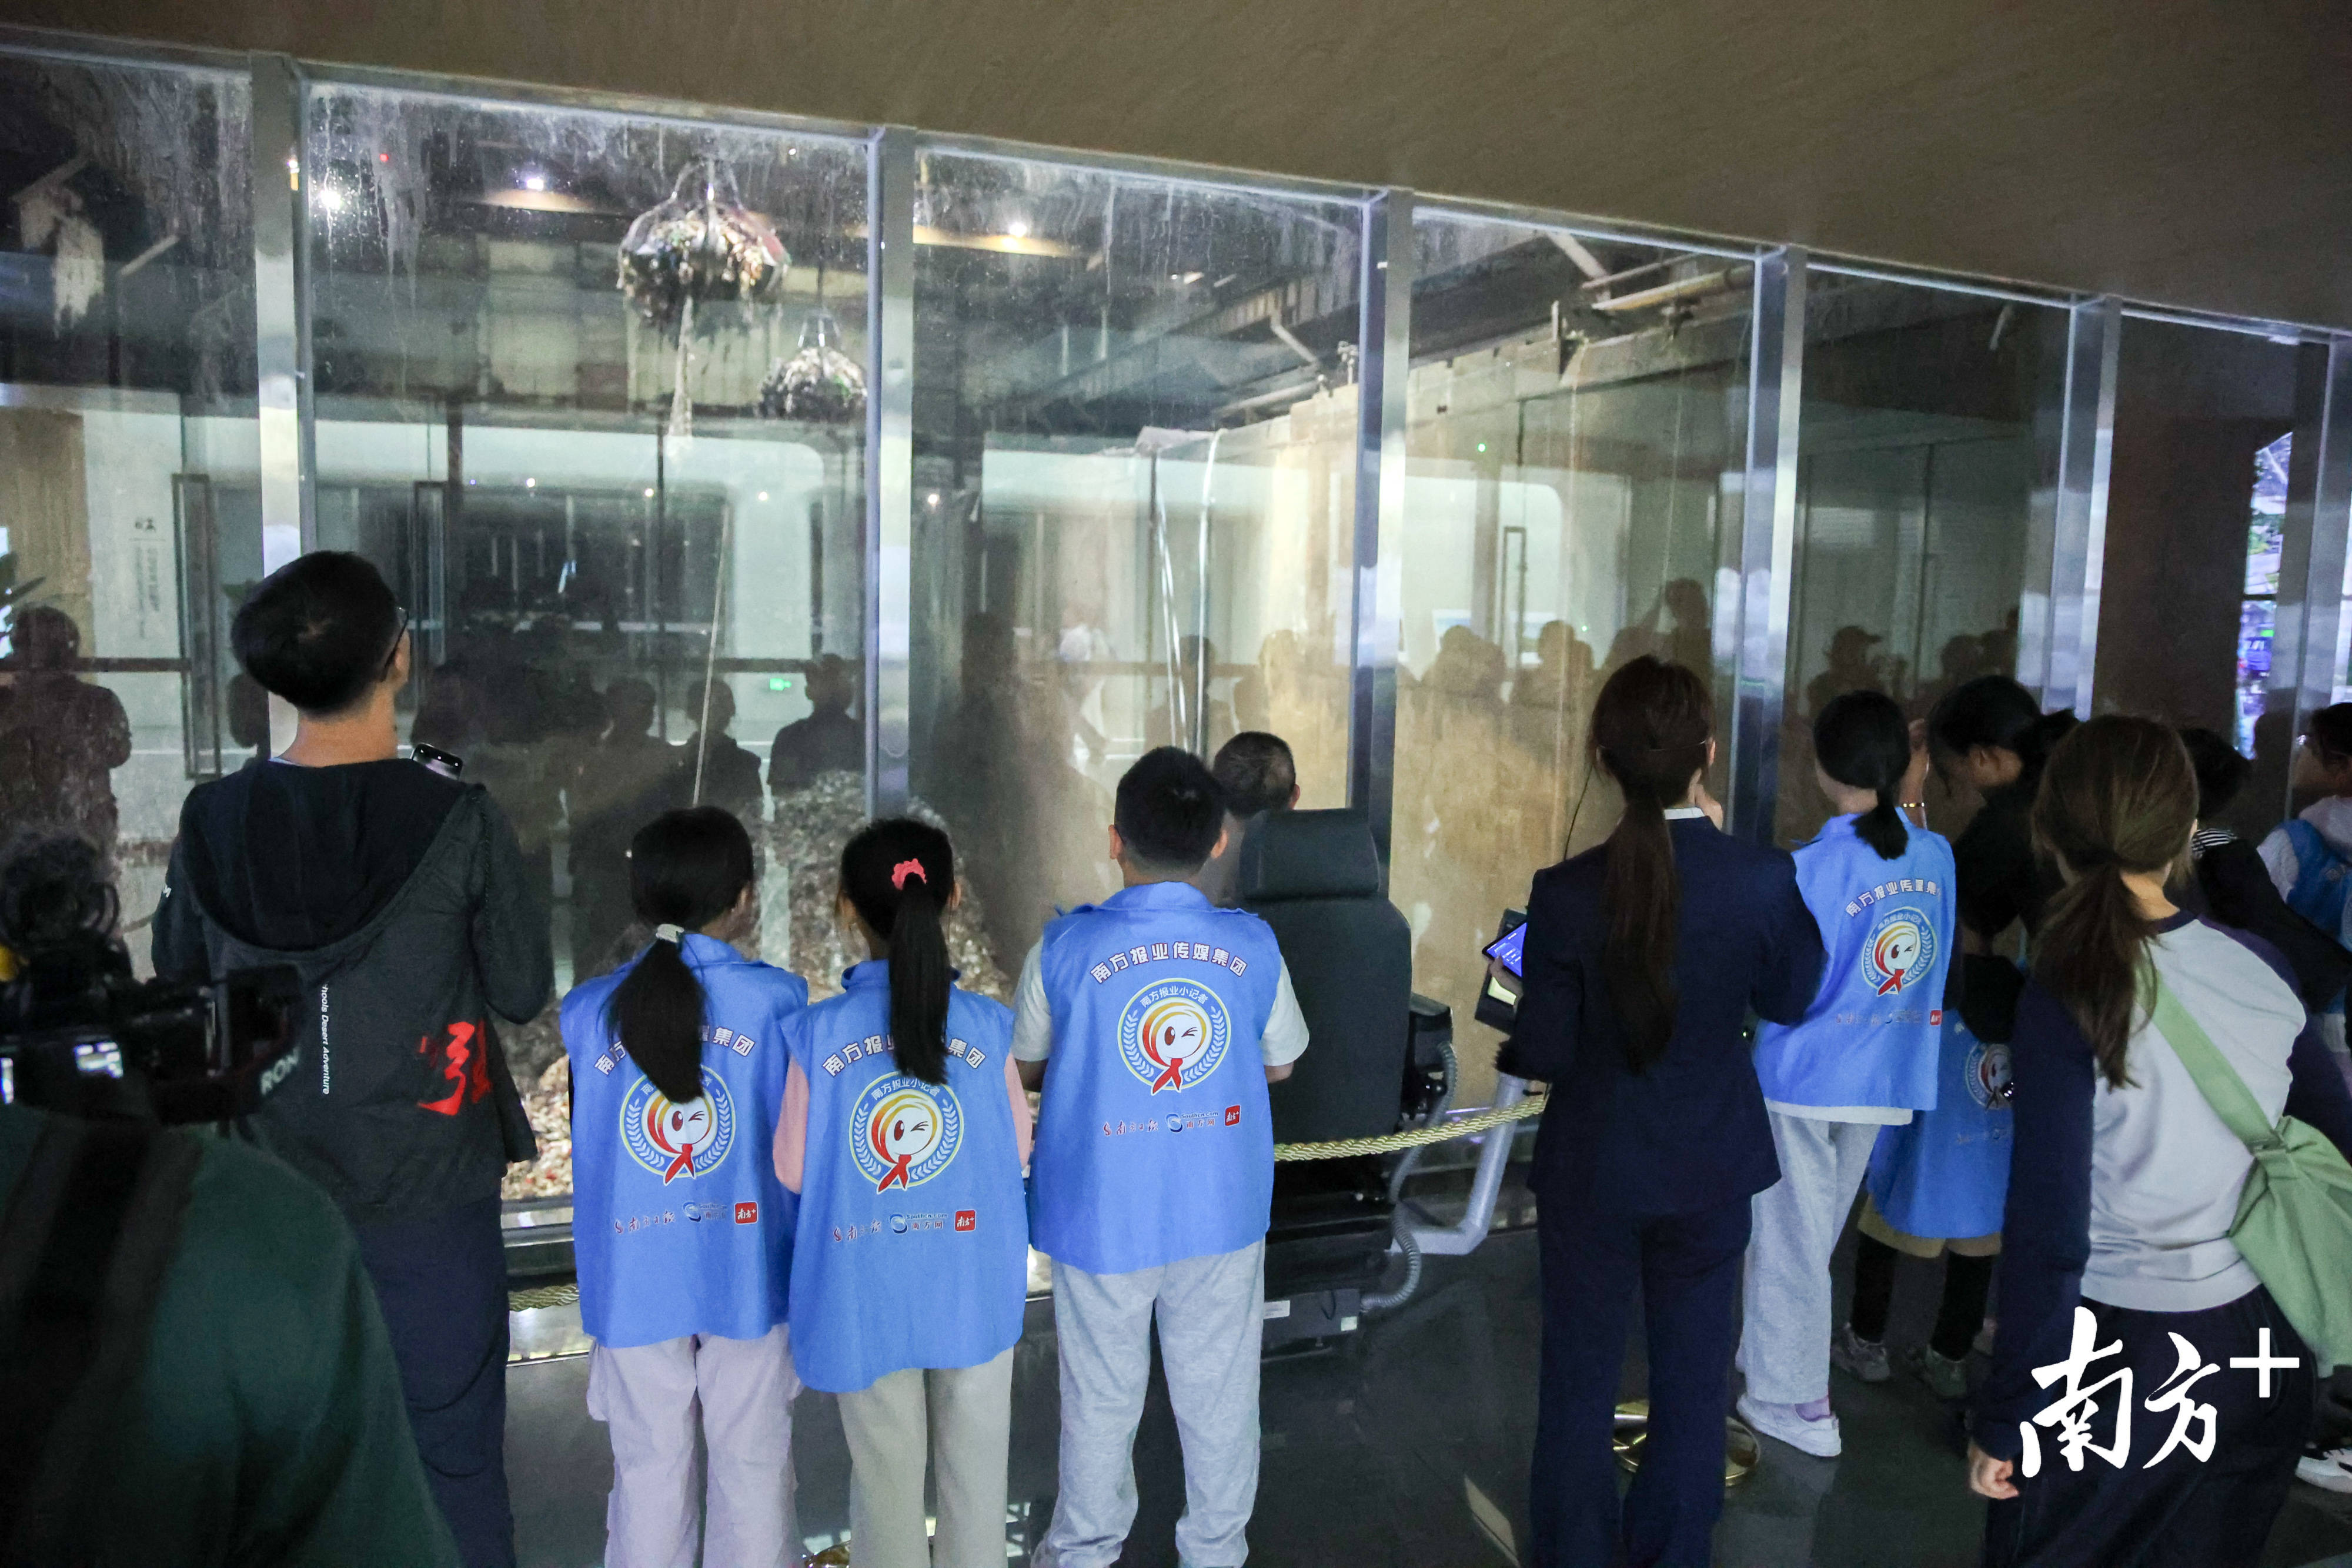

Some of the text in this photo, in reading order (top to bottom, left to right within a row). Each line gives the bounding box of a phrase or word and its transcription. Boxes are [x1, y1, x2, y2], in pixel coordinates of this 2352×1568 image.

[1090, 941, 1248, 984] 南方报业传媒集团
[1140, 986, 1210, 1008] 南方报业小记者
[321, 1014, 329, 1045] Desert
[322, 1046, 330, 1095] Adventure
[1187, 1118, 1215, 1128] 南方网
